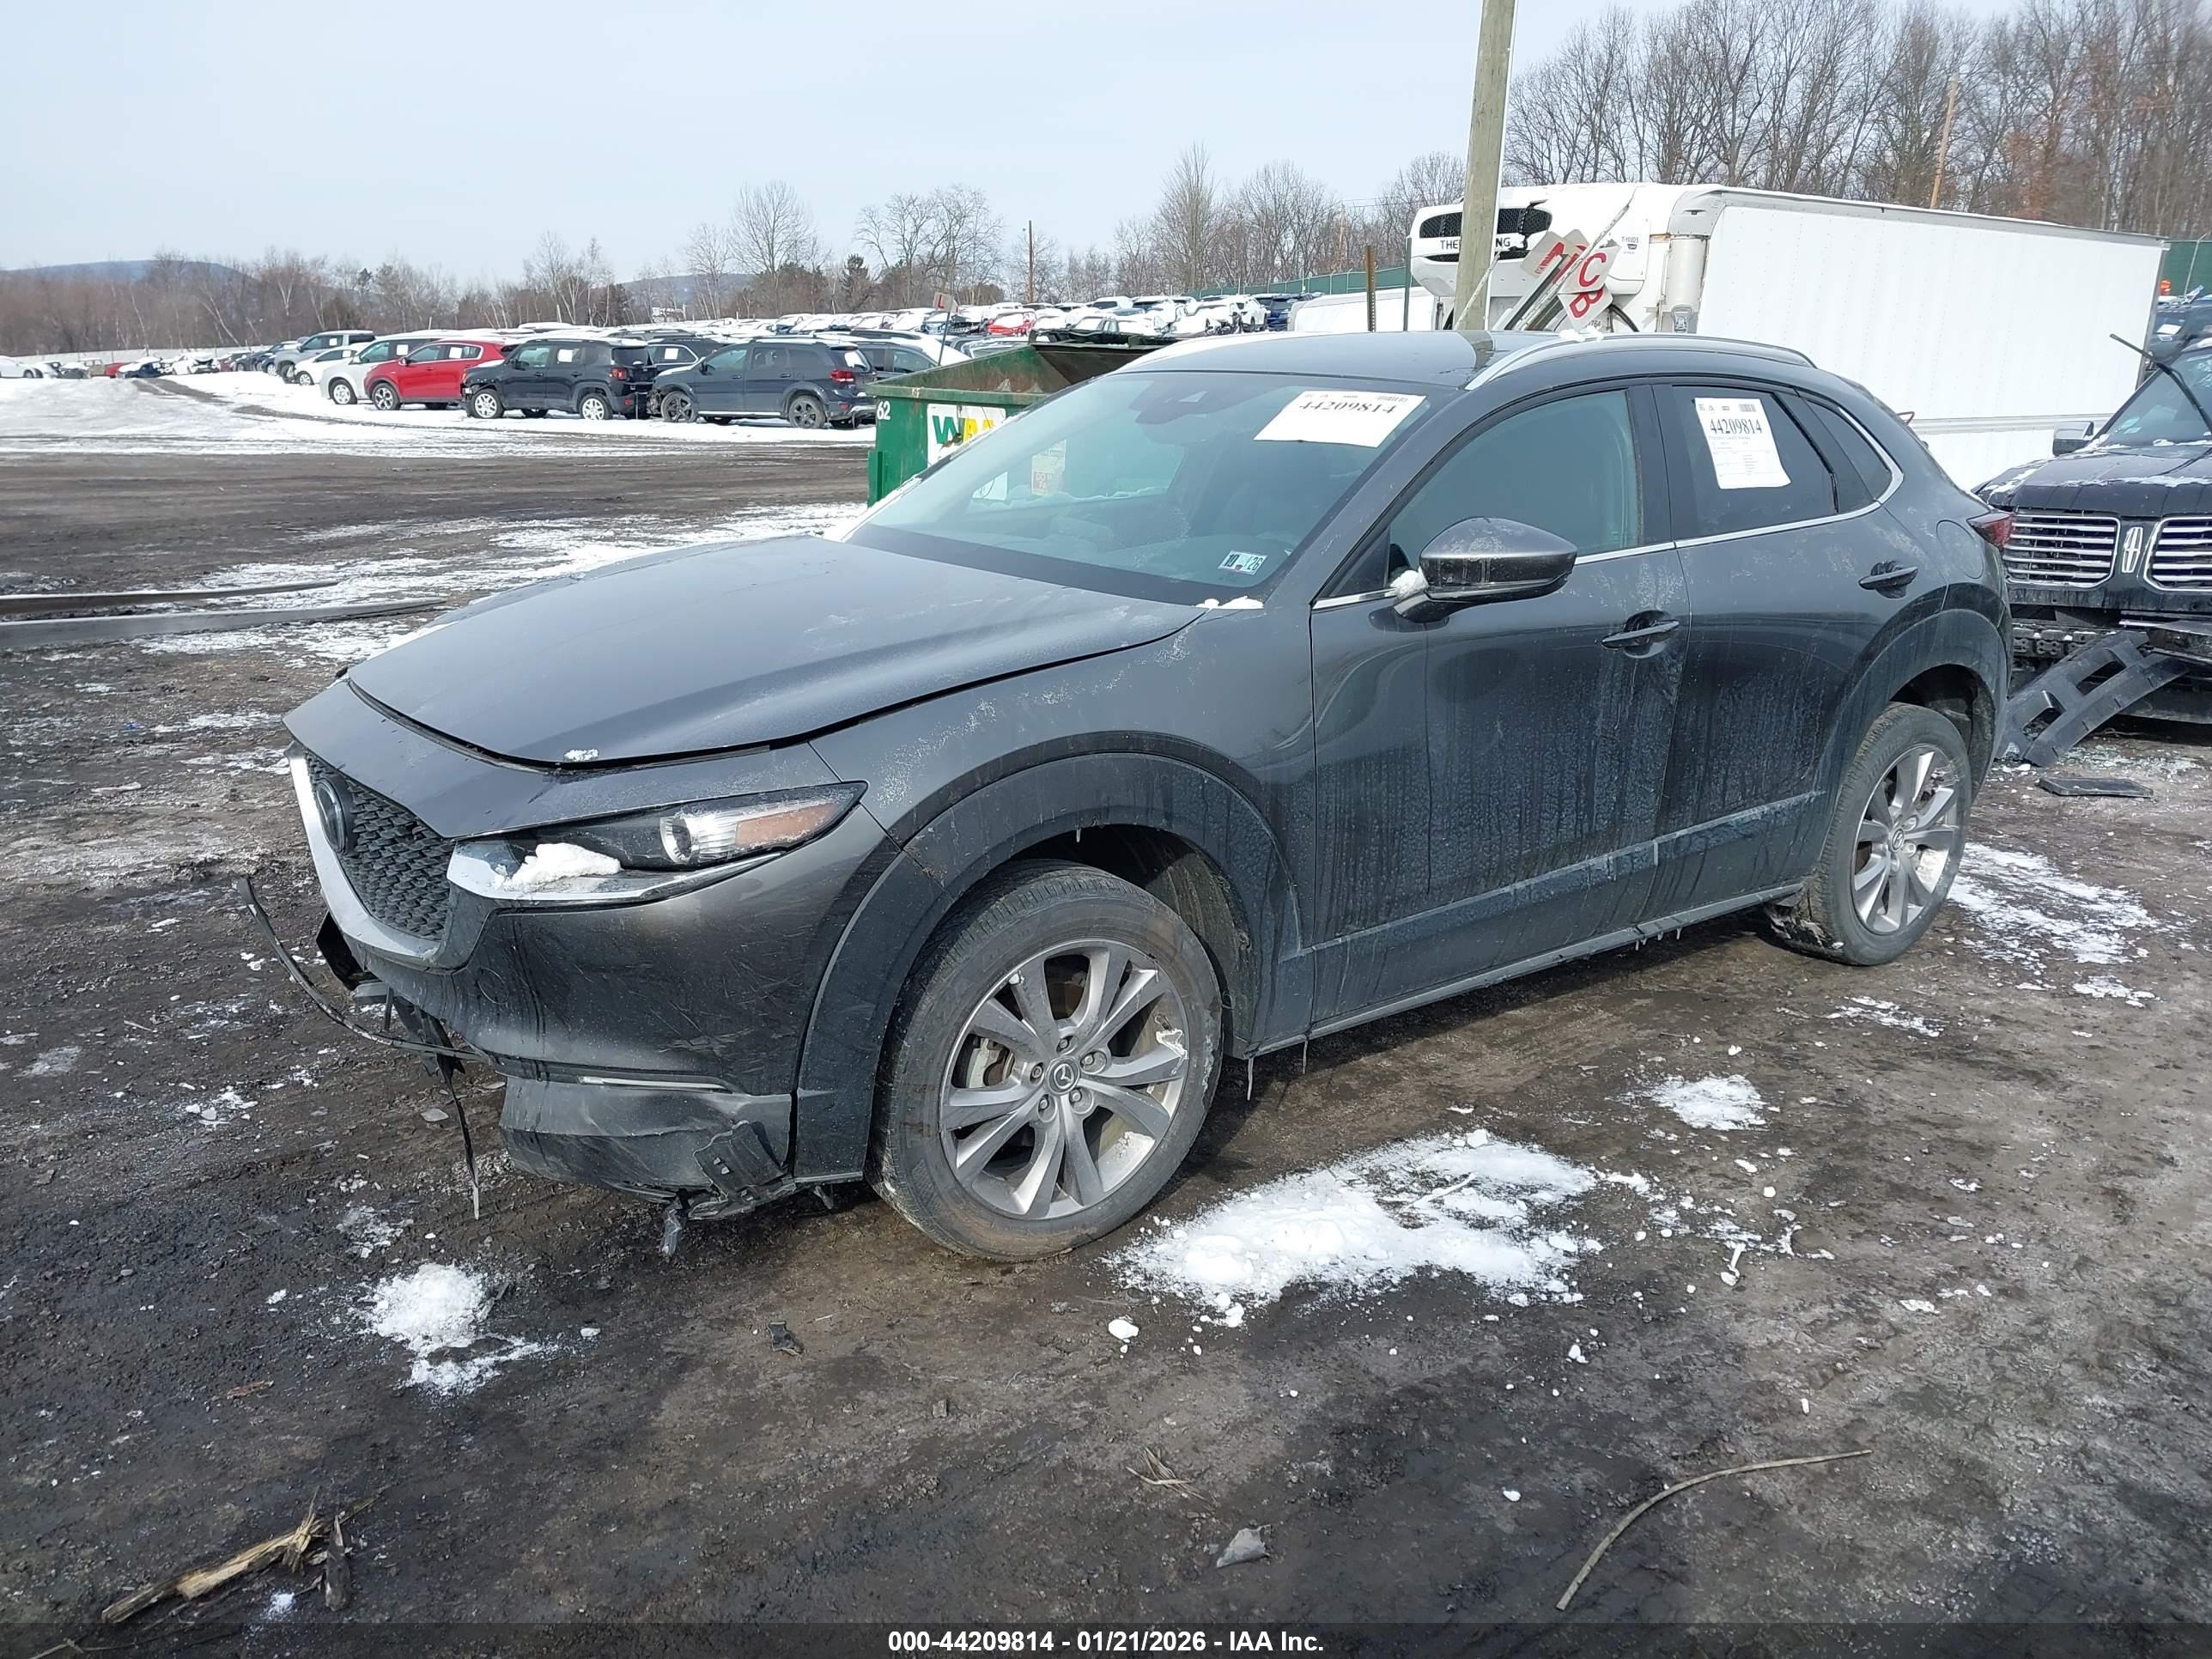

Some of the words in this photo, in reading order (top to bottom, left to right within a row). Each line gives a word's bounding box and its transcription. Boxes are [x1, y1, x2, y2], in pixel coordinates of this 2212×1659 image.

[1495, 237, 1510, 248] NG
[1579, 252, 1607, 287] C
[877, 400, 891, 421] 62
[1299, 401, 1398, 414] 44209814
[1711, 418, 1763, 434] 44209814
